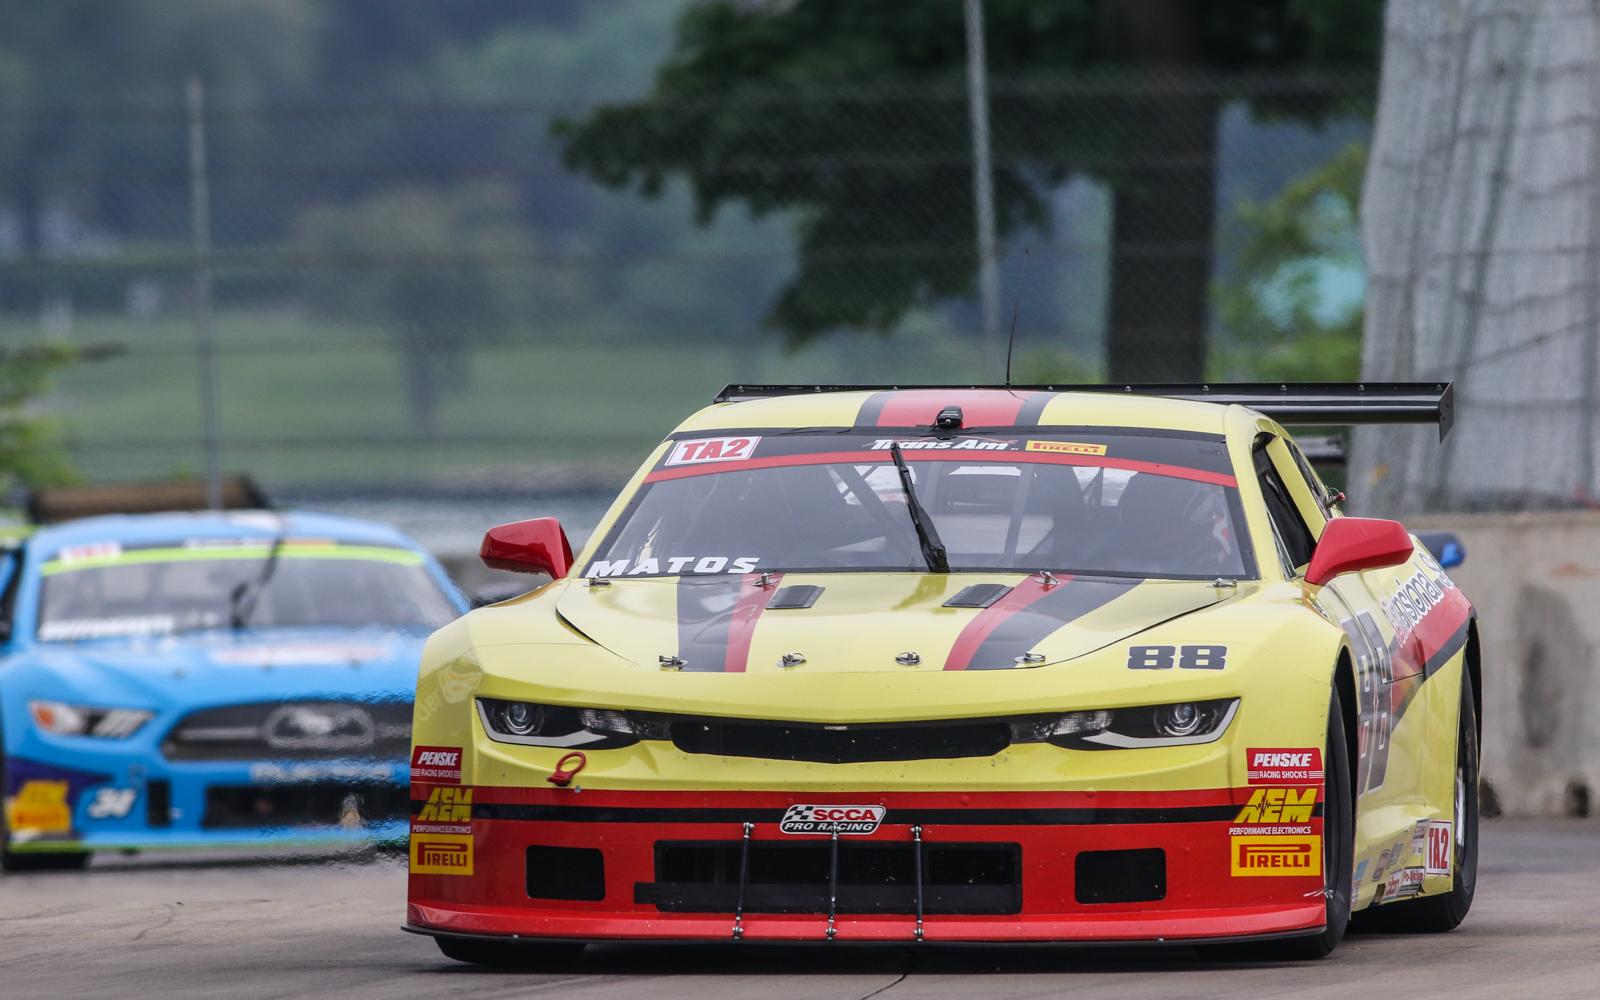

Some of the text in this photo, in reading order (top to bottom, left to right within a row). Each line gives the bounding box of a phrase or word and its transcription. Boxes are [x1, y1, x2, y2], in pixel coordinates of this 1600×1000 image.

[681, 439, 750, 461] TA2
[870, 439, 953, 450] Trans
[954, 439, 1009, 450] Am
[1032, 442, 1100, 453] PIRELLI
[584, 556, 760, 578] MATOS
[1127, 645, 1228, 670] 88
[417, 752, 458, 766] PENSKE
[1253, 753, 1312, 767] PENSKE
[1259, 771, 1308, 779] RACING SHOCKS
[417, 787, 472, 822] AEM
[1233, 788, 1318, 823] AEM
[813, 809, 876, 820] SCCA
[784, 822, 874, 831] PRO RACING
[1228, 826, 1311, 835] PERFORMANCE ELECTRONICS
[417, 842, 468, 867] PIRELLI
[1239, 843, 1312, 868] PIRELLI
[1429, 828, 1449, 869] TA2
